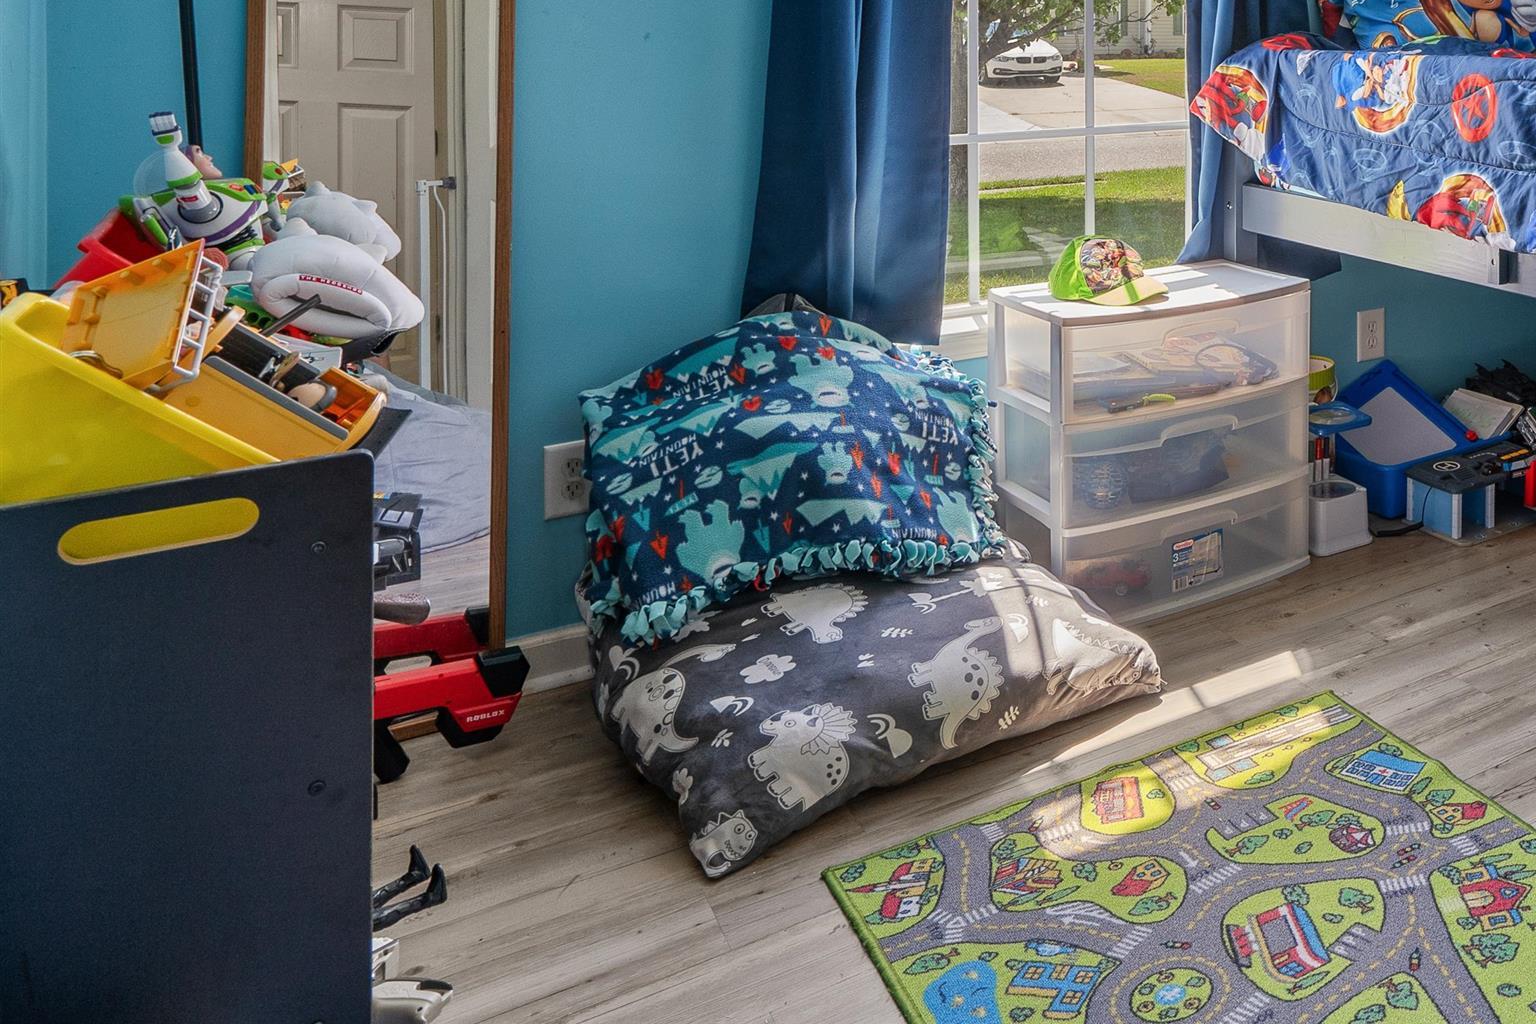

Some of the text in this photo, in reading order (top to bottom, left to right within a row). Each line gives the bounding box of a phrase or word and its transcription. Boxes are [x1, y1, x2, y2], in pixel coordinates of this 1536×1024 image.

[650, 442, 704, 478] YETI
[1173, 553, 1179, 563] 3
[466, 709, 505, 723] ROBLOX
